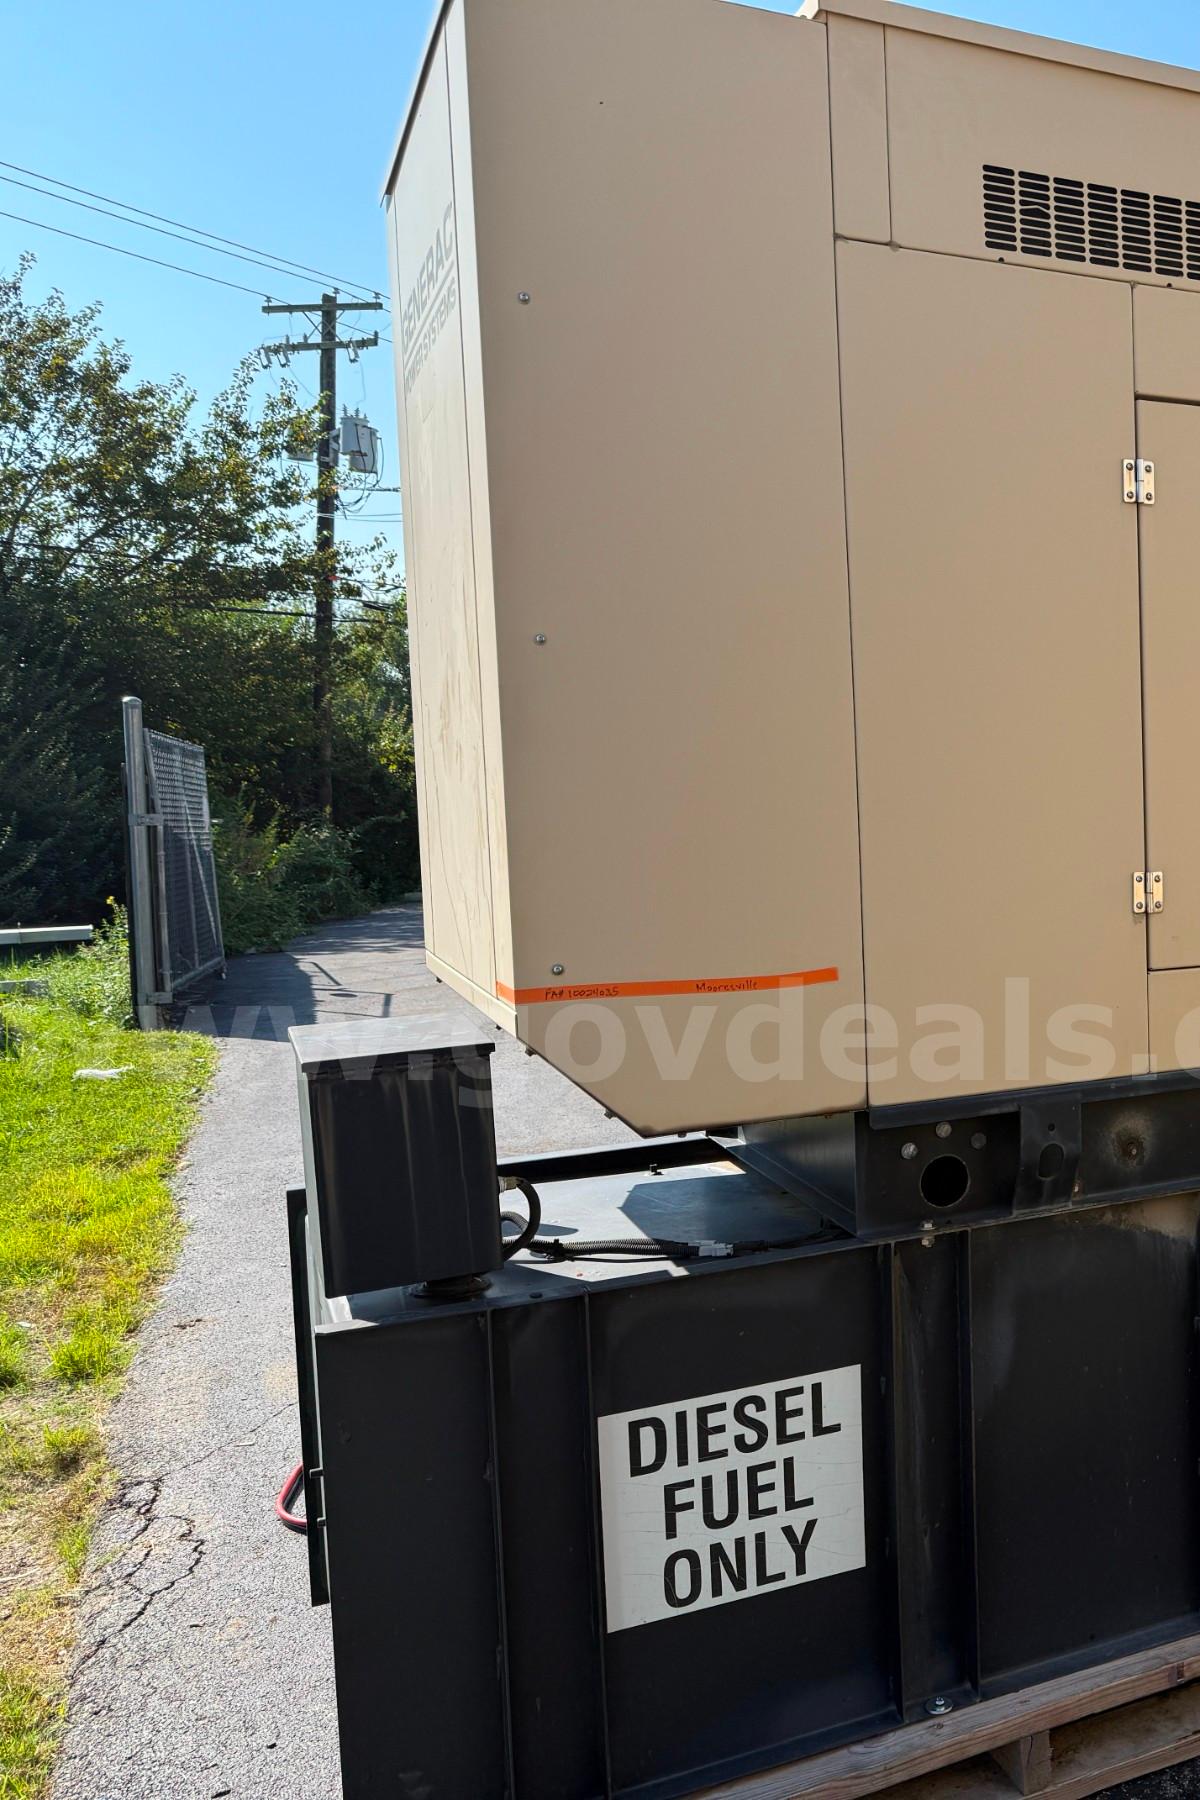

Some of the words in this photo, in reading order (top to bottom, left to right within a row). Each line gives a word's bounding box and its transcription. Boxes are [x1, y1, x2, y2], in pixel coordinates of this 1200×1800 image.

[402, 201, 453, 351] GENERAC
[405, 350, 424, 394] POWER
[423, 276, 457, 361] SYSTEMS
[628, 1381, 842, 1478] DIESEL
[663, 1455, 815, 1540] FUEL
[663, 1518, 819, 1609] ONLY
